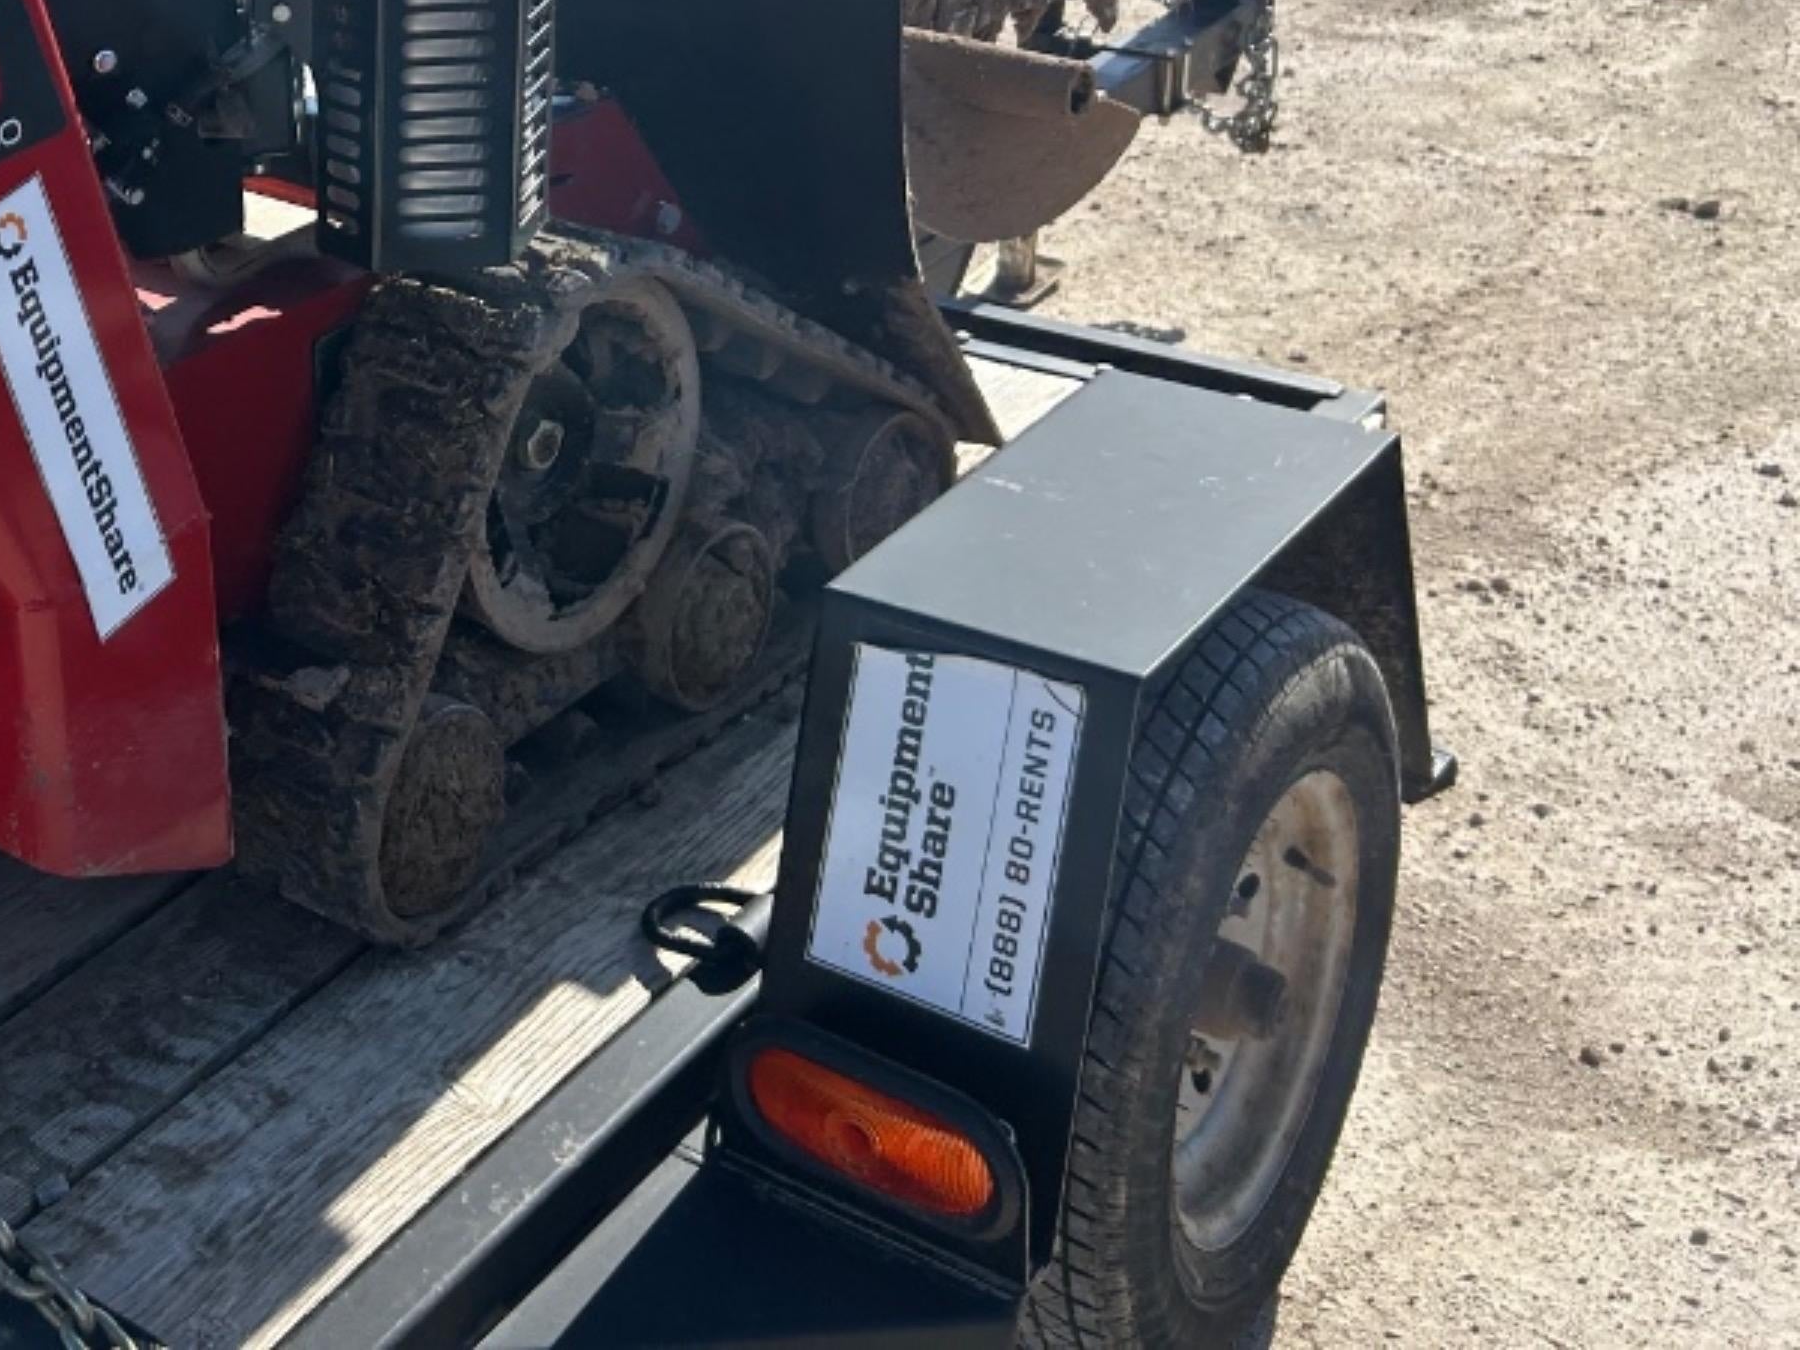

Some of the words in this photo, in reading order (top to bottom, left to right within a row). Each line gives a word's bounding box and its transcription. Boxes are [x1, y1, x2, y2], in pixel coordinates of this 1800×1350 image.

[8, 258, 137, 595] EquipmentShare
[864, 652, 935, 904] Equipment
[904, 780, 957, 919] Share
[1005, 707, 1056, 887] 80-RENTS
[984, 894, 1027, 996] (888)
